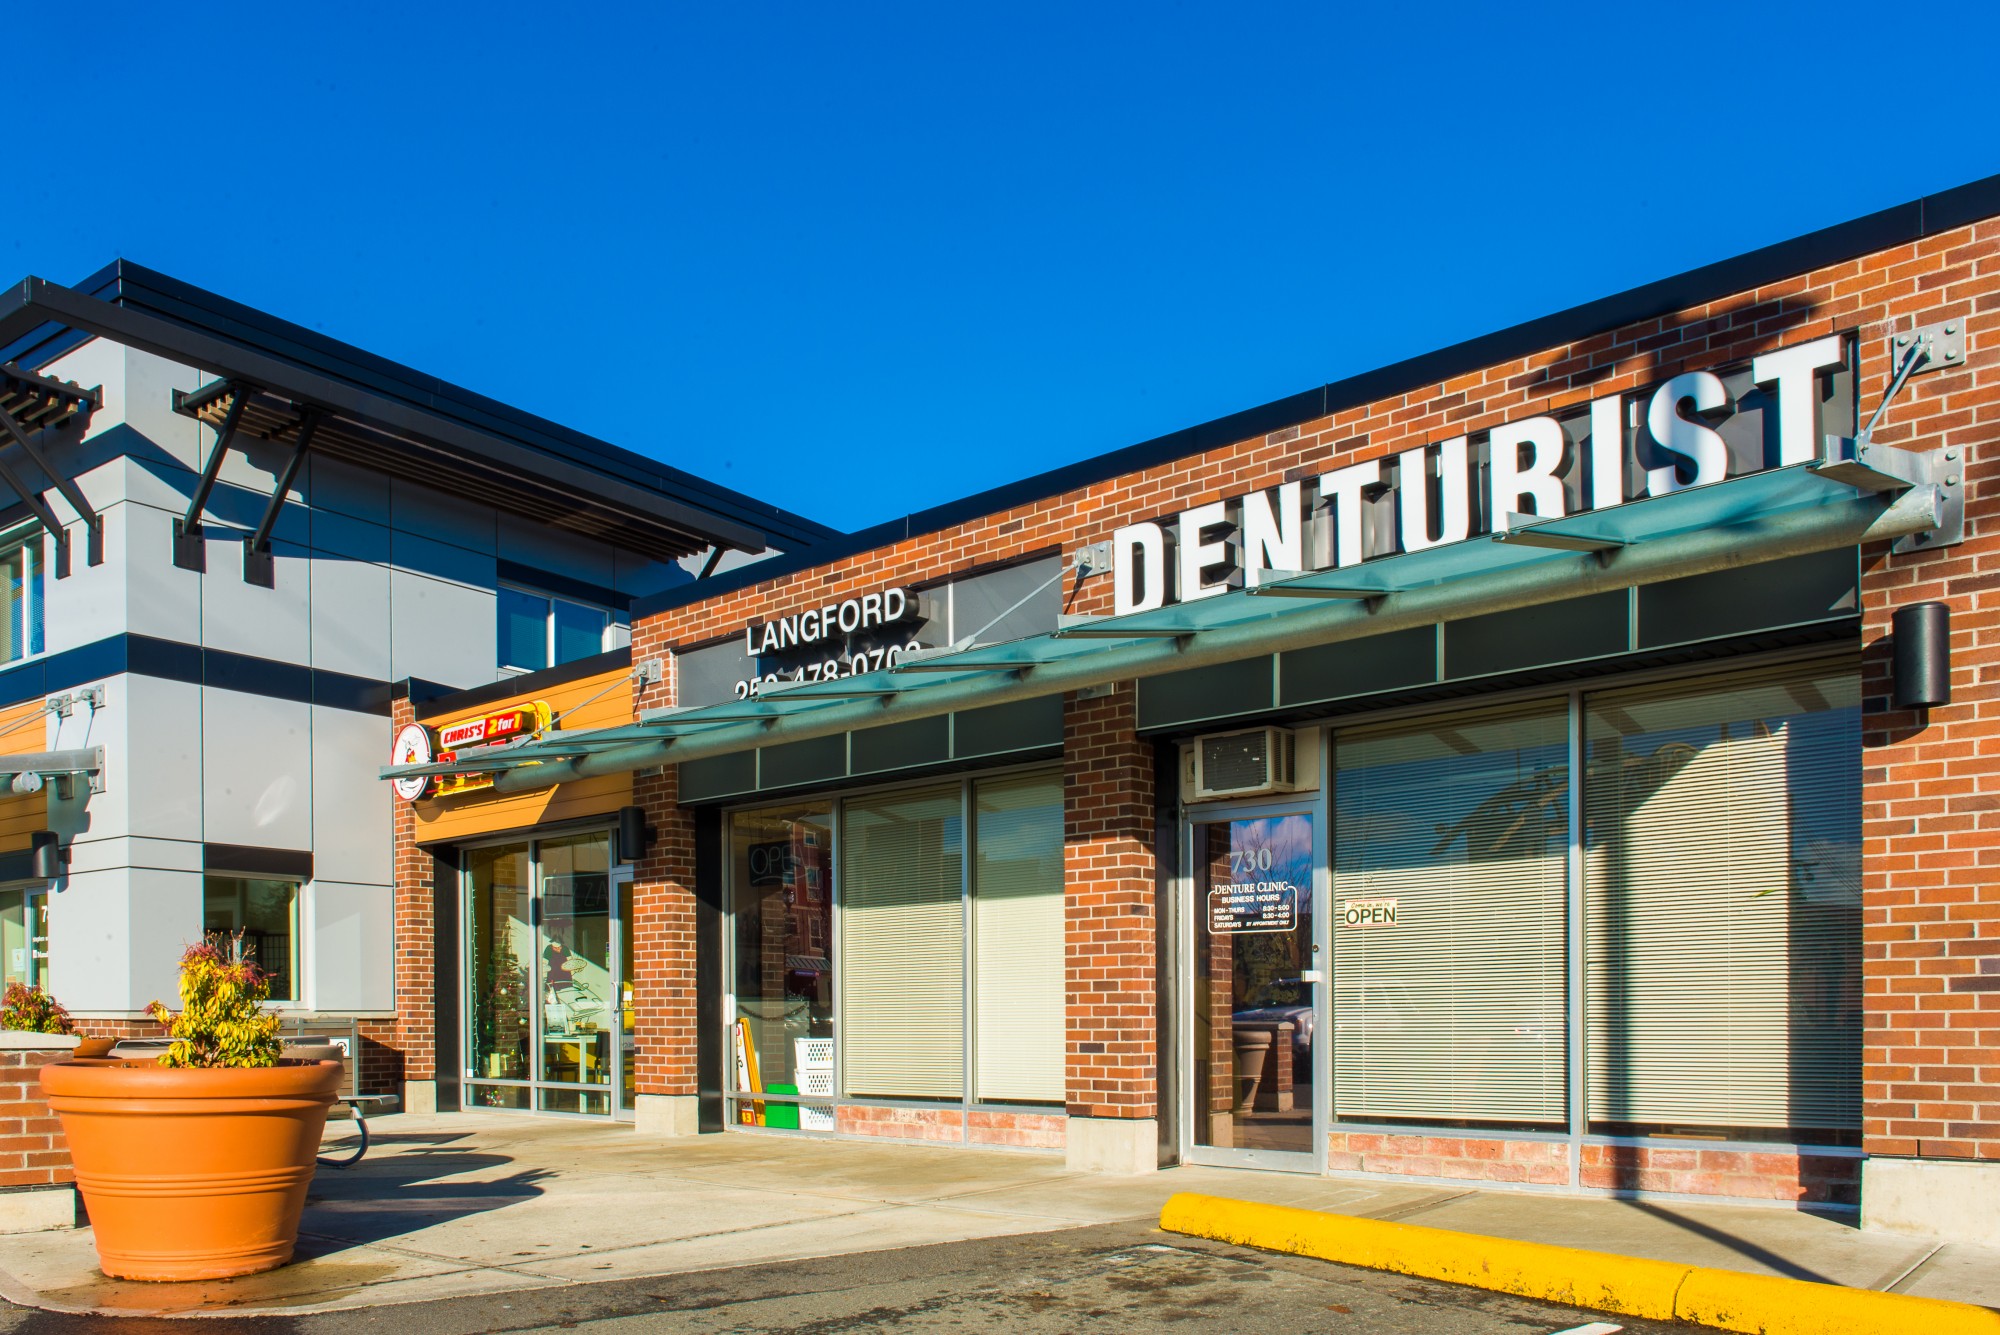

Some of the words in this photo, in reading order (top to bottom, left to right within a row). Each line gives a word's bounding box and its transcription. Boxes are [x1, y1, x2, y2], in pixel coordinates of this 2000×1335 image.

[1112, 335, 1843, 617] DENTURIST
[747, 587, 906, 657] LANGFORD
[443, 724, 483, 744] CHRIS'S
[1230, 848, 1272, 873] 730
[1214, 883, 1255, 895] DENTURE
[1257, 881, 1288, 892] CLINIC
[1222, 895, 1254, 904] BUSINESS
[1256, 894, 1280, 902] HOURS
[1345, 907, 1396, 924] OPEN
